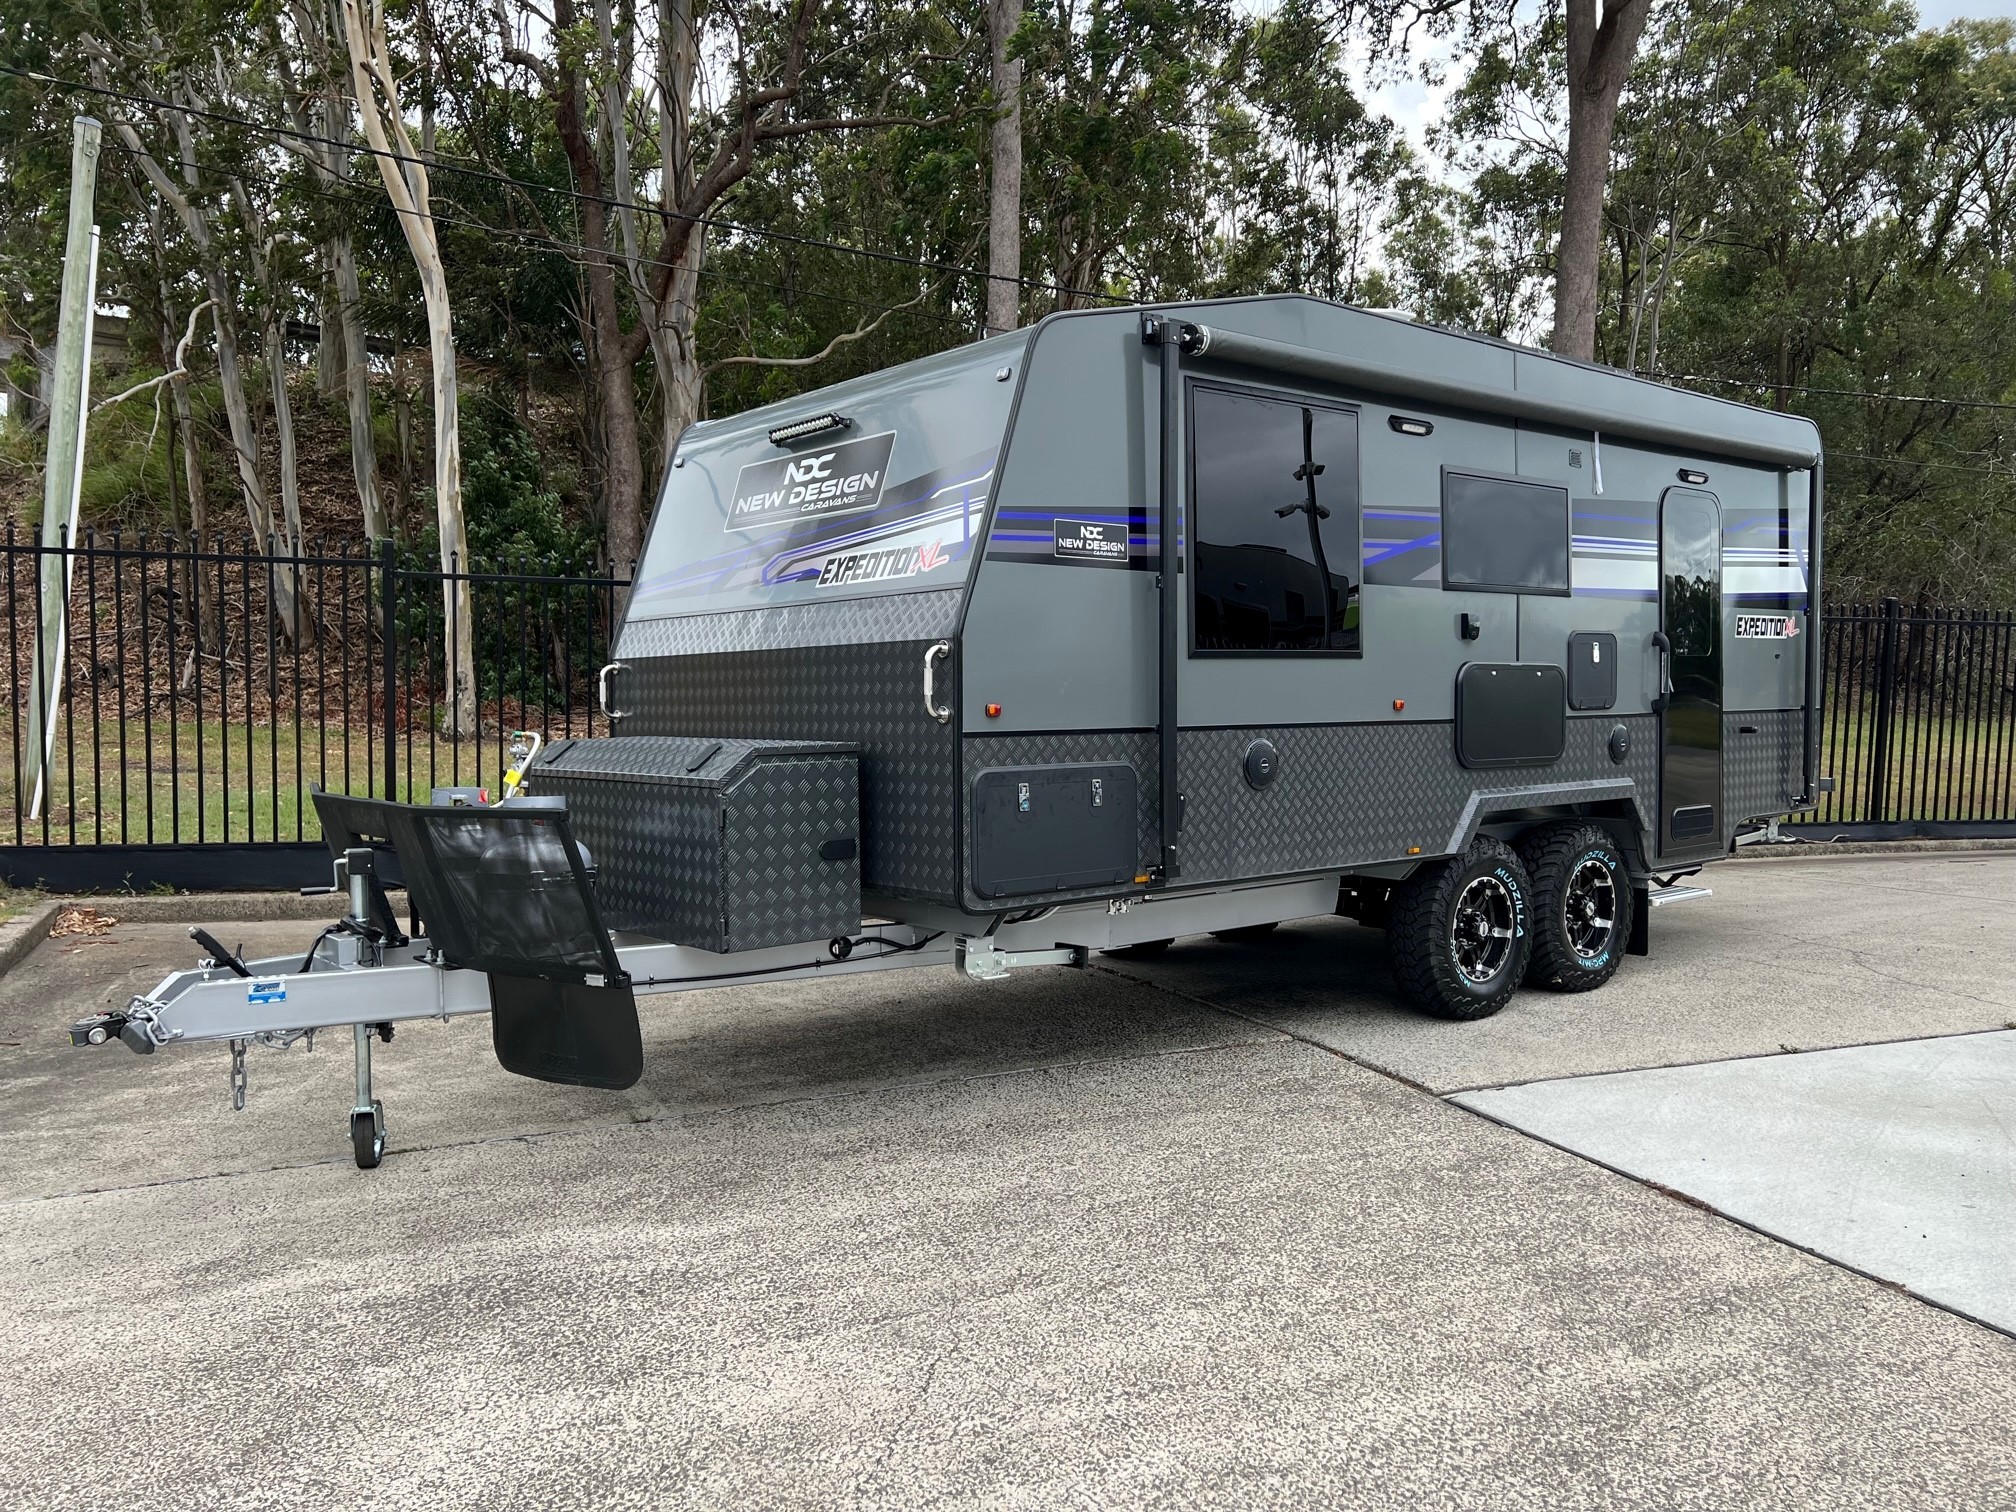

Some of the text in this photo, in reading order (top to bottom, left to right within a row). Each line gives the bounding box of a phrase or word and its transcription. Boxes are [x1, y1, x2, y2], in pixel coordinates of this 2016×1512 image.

[783, 452, 836, 485] NDC
[735, 470, 879, 514] NEW DESIGN
[800, 494, 857, 512] CARAVANS
[1058, 537, 1125, 552] NEW DESIGN
[1080, 525, 1104, 540] NDC
[1494, 867, 1525, 938] MUDZILLA
